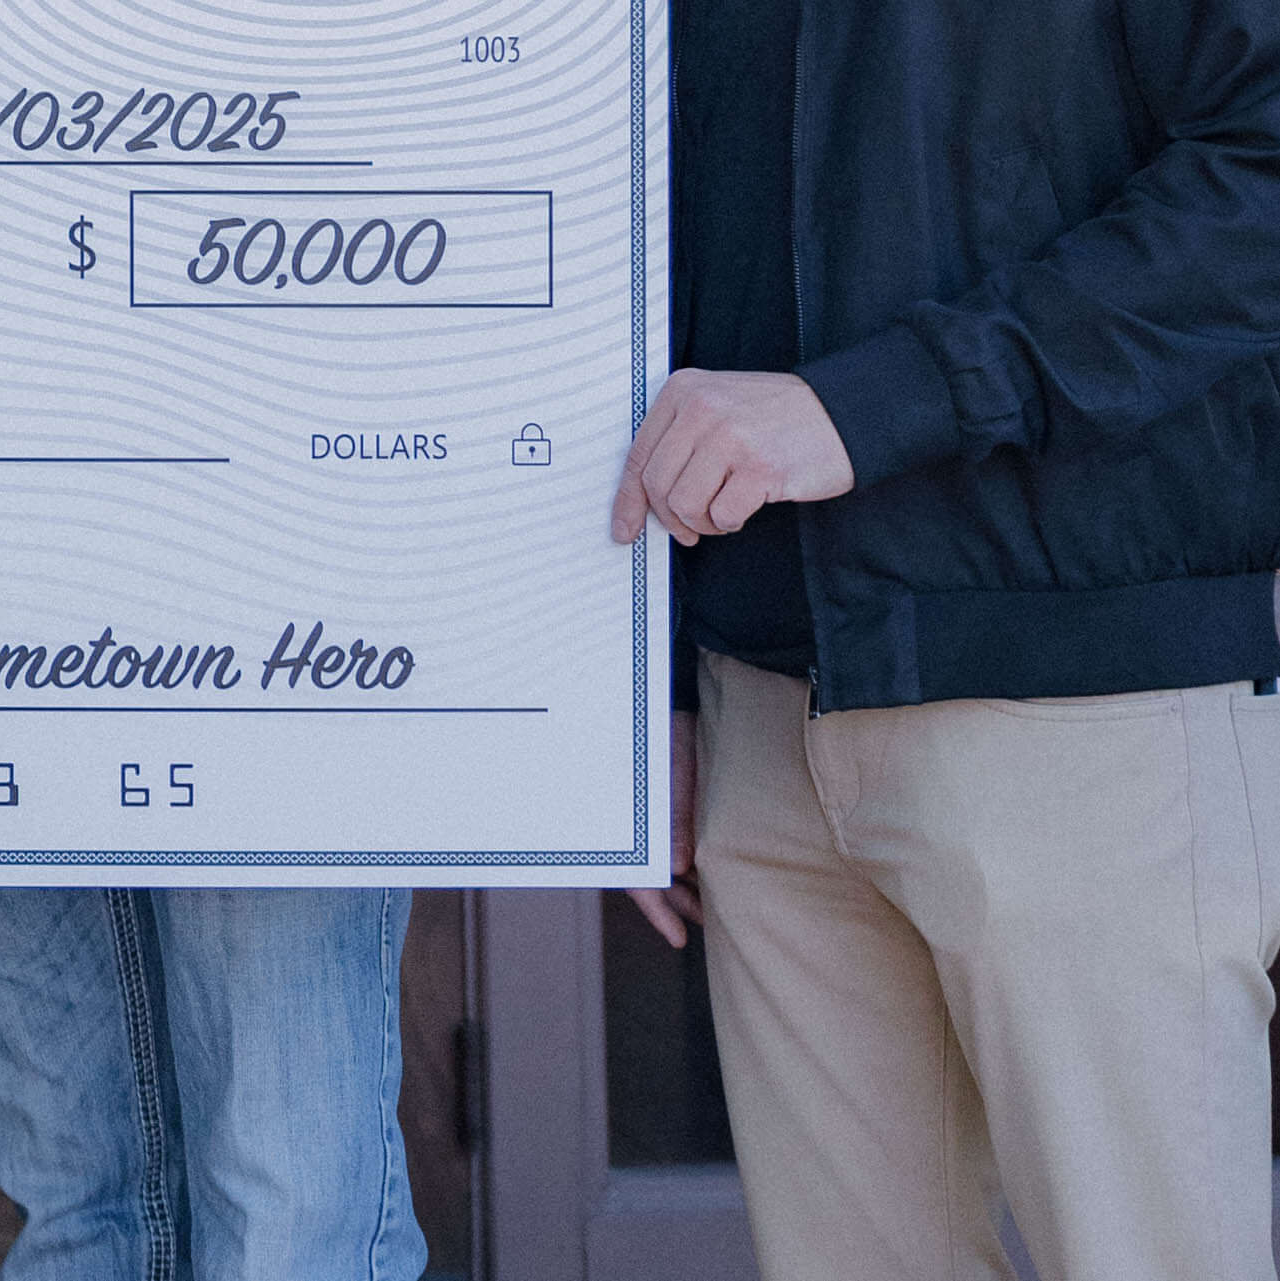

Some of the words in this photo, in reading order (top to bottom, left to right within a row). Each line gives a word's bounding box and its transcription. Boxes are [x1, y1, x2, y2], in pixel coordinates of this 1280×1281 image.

[459, 34, 521, 65] 1003
[67, 213, 98, 281] $
[186, 216, 448, 291] 50,000
[310, 432, 449, 461] DOLLARS
[259, 619, 417, 692] Hero
[119, 762, 195, 808] 65
